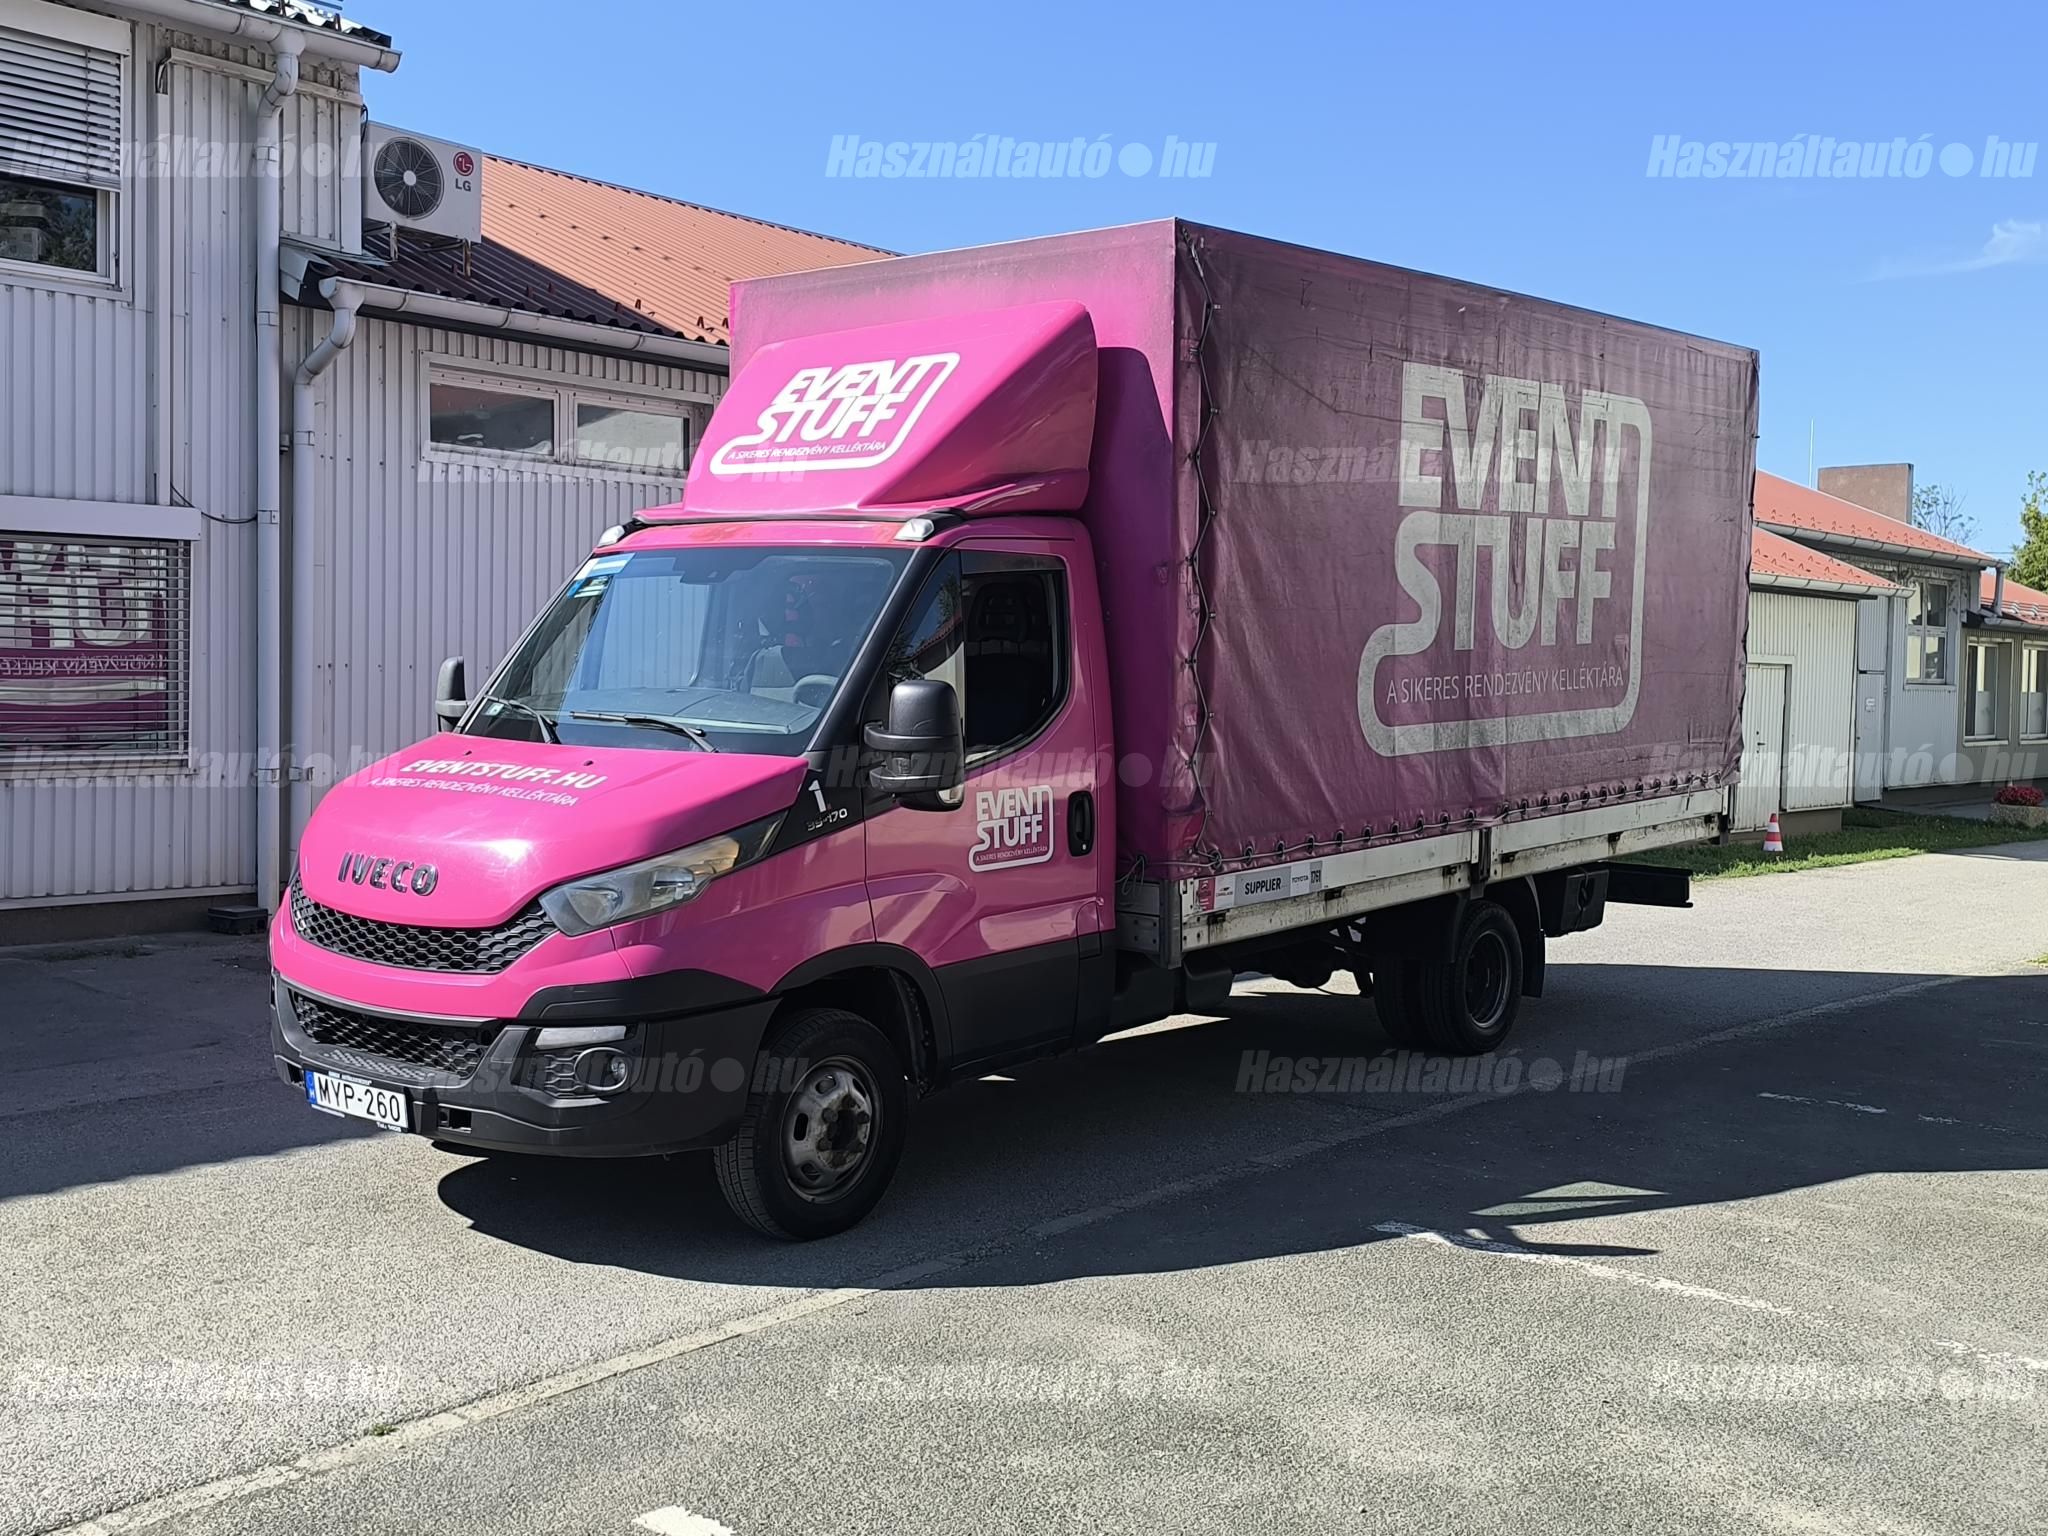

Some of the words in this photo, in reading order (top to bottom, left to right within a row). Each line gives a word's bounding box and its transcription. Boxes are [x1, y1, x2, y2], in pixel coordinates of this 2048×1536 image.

[455, 178, 472, 192] LG
[772, 354, 940, 404] EVENT
[756, 392, 910, 443] STUFF
[1398, 361, 1640, 517] EVENT
[1395, 510, 1616, 655] STUFF
[1386, 679, 1398, 704] A
[1401, 675, 1460, 703] SIKERES
[1464, 665, 1549, 698] RENDEZVÉNY
[1551, 661, 1624, 691] KELLÉKTÁRA
[400, 759, 607, 789] EVENTSTUFF.HU
[976, 786, 1048, 821] EVENT
[976, 814, 1043, 852] STUFF
[338, 851, 439, 896] IVECO
[1245, 877, 1281, 895] SUPPLIER
[318, 1076, 400, 1122] MYP-260
